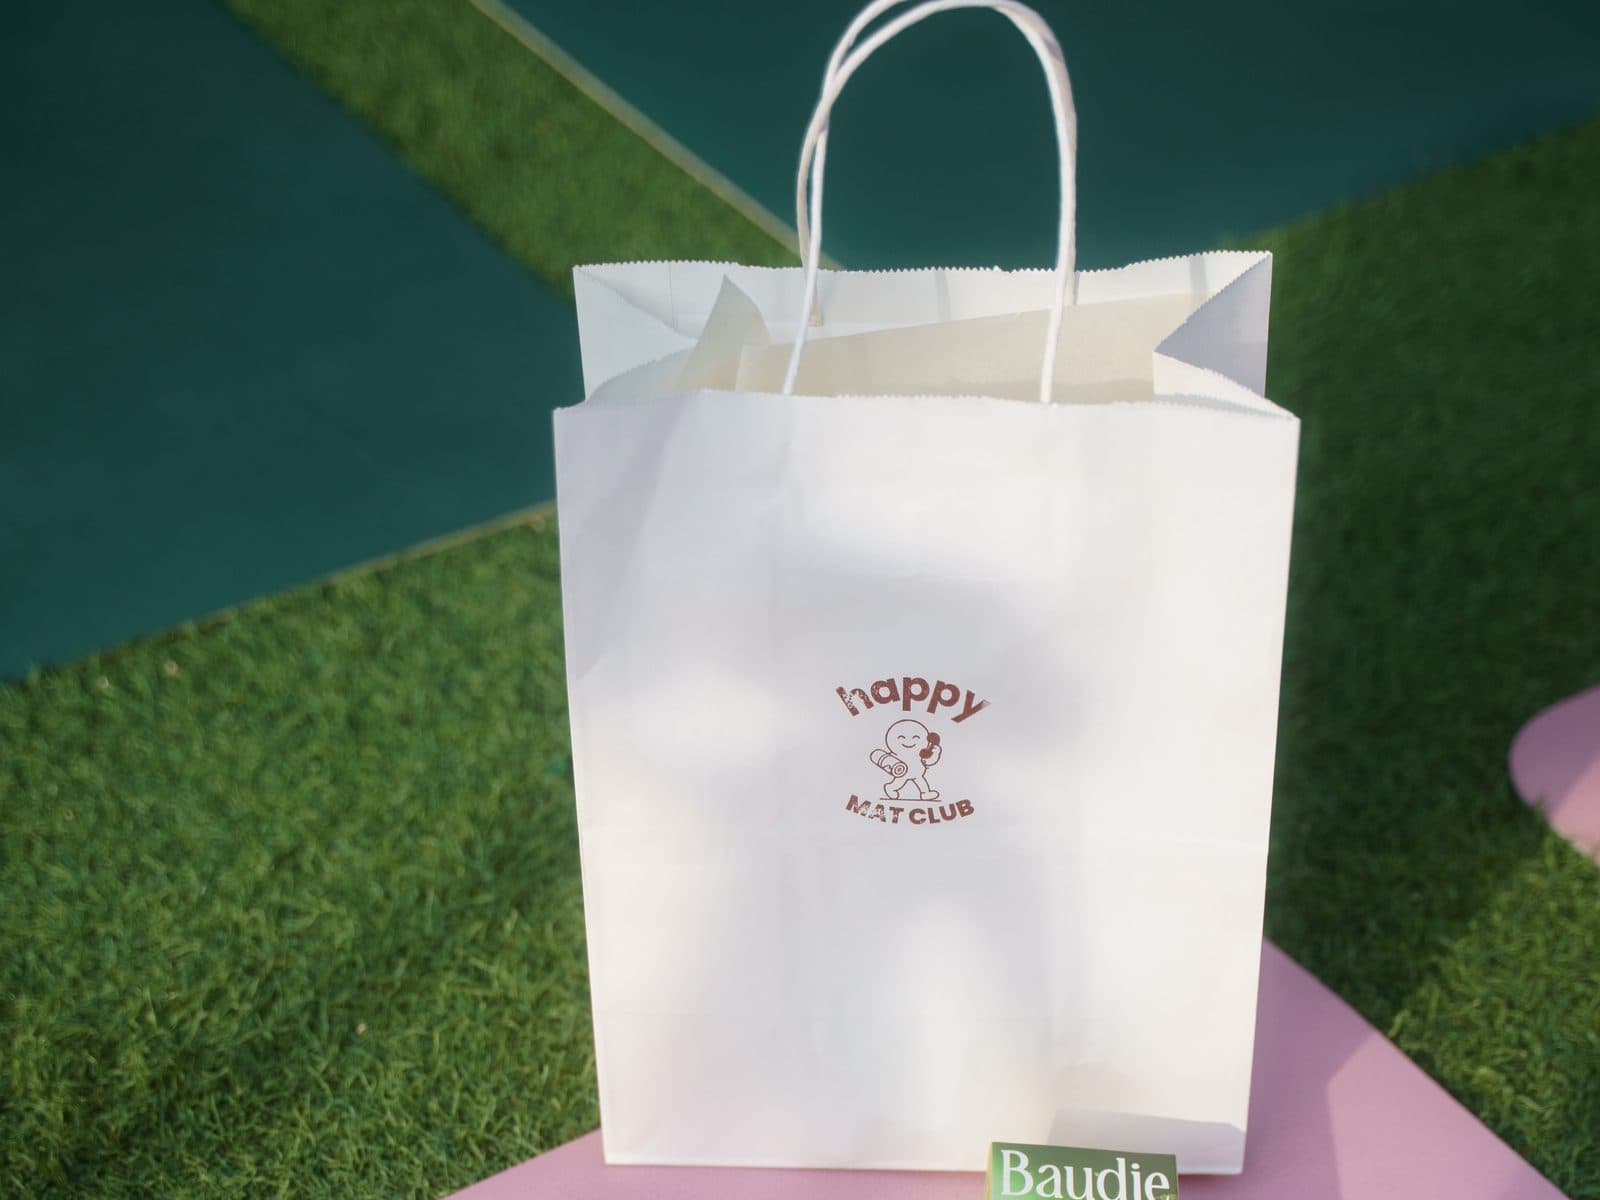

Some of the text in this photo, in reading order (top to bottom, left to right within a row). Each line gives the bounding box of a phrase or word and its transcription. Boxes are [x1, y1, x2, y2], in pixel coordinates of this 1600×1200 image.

[836, 676, 992, 723] happy
[845, 793, 975, 825] MAT CLUB
